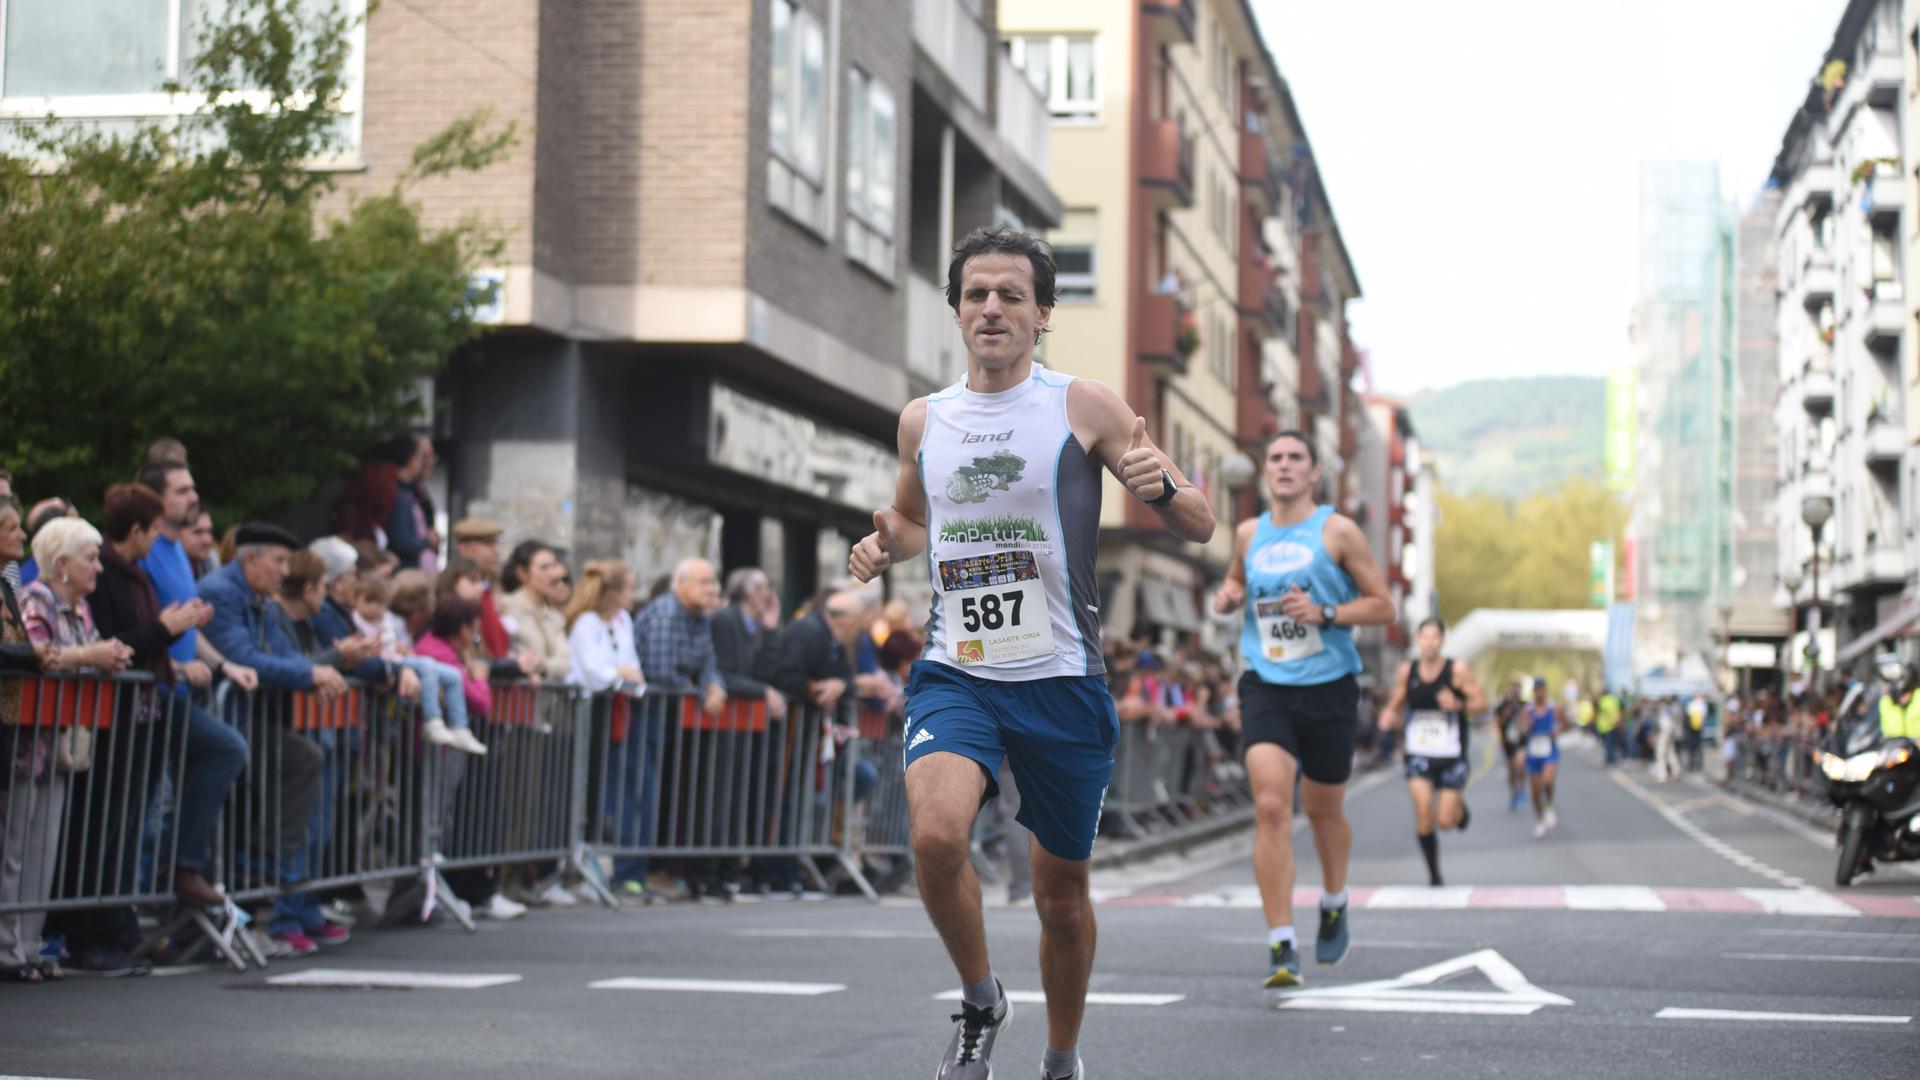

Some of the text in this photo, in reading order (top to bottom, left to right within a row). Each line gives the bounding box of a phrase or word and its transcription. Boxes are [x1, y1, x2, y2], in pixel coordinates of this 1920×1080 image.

[961, 429, 1014, 444] land
[962, 590, 1024, 632] 587
[989, 632, 1041, 645] LASARTE-ORIA
[1271, 621, 1307, 640] 466
